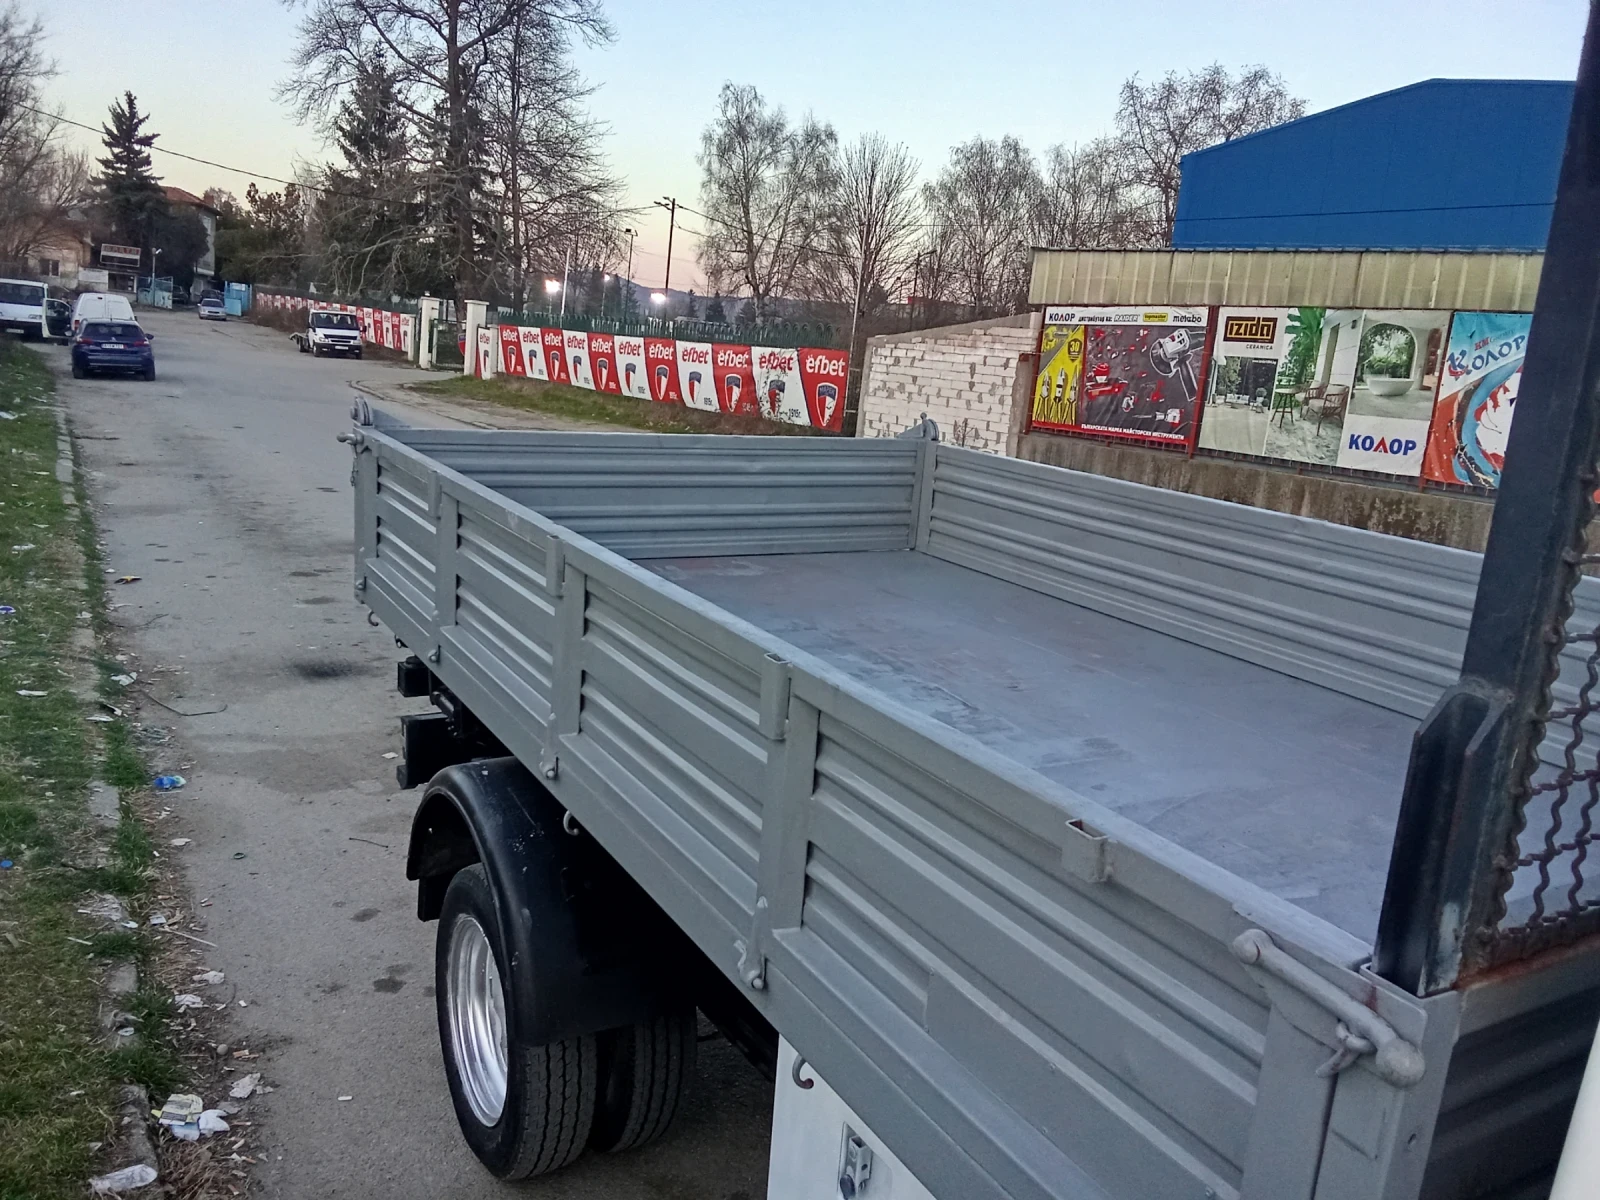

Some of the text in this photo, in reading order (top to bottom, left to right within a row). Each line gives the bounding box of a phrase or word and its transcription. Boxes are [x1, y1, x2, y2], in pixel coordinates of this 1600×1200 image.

[1049, 313, 1076, 322] КОЛОР
[1114, 314, 1138, 322] RAIDER
[1172, 314, 1202, 323] metabo
[502, 329, 518, 342] efbet
[522, 330, 540, 344] efbet
[544, 332, 562, 346] efbet
[567, 334, 586, 350] efbet
[591, 338, 613, 353] efbet
[618, 340, 642, 357] efbet
[648, 342, 674, 360] efbet
[1070, 341, 1080, 352] 30
[681, 346, 710, 364] efbet
[717, 349, 748, 368] efbet
[758, 350, 794, 371] efbet
[1447, 334, 1526, 376] КОЛОР
[805, 354, 846, 377] efbet
[1348, 433, 1417, 456] КОЛОР
